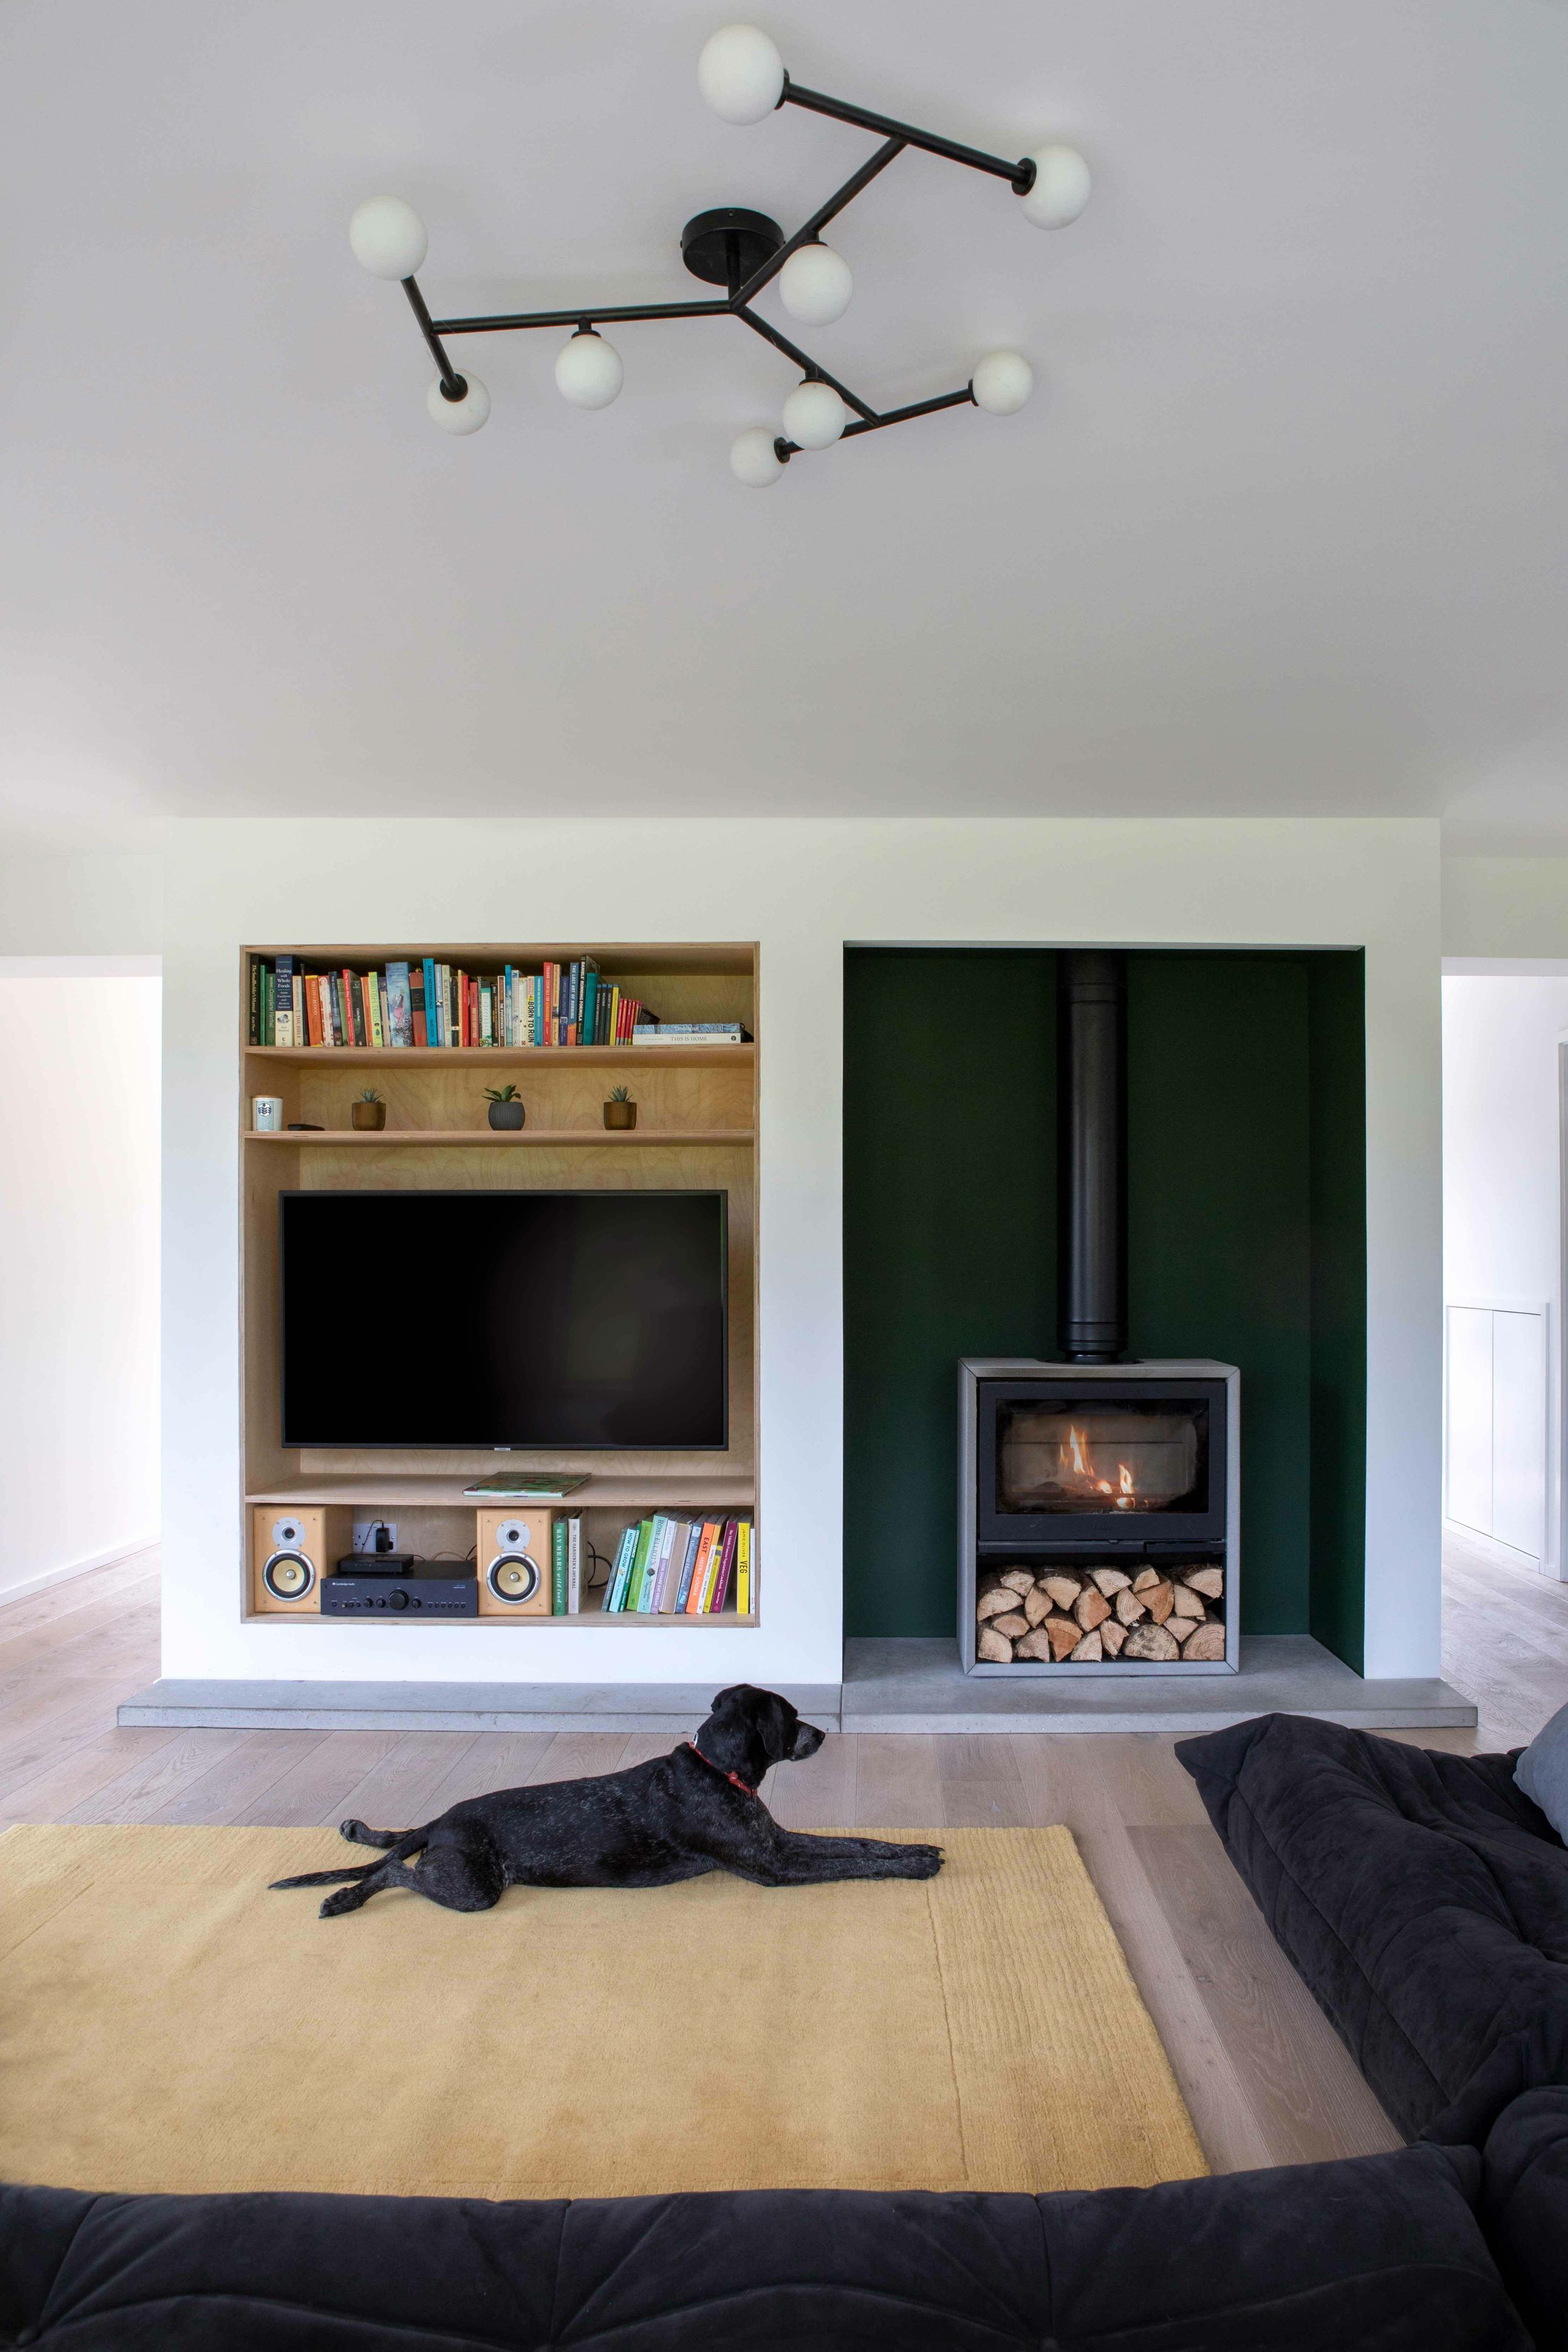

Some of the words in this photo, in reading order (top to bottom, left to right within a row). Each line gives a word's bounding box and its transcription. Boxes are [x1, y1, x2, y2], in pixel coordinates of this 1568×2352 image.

[528, 1019, 534, 1028] TO
[655, 1520, 664, 1537] ROSE
[651, 1538, 661, 1565] ELLIOT'S
[681, 1563, 690, 1587] Handbook
[739, 1561, 748, 1573] VEG
[693, 1576, 701, 1596] SODHA
